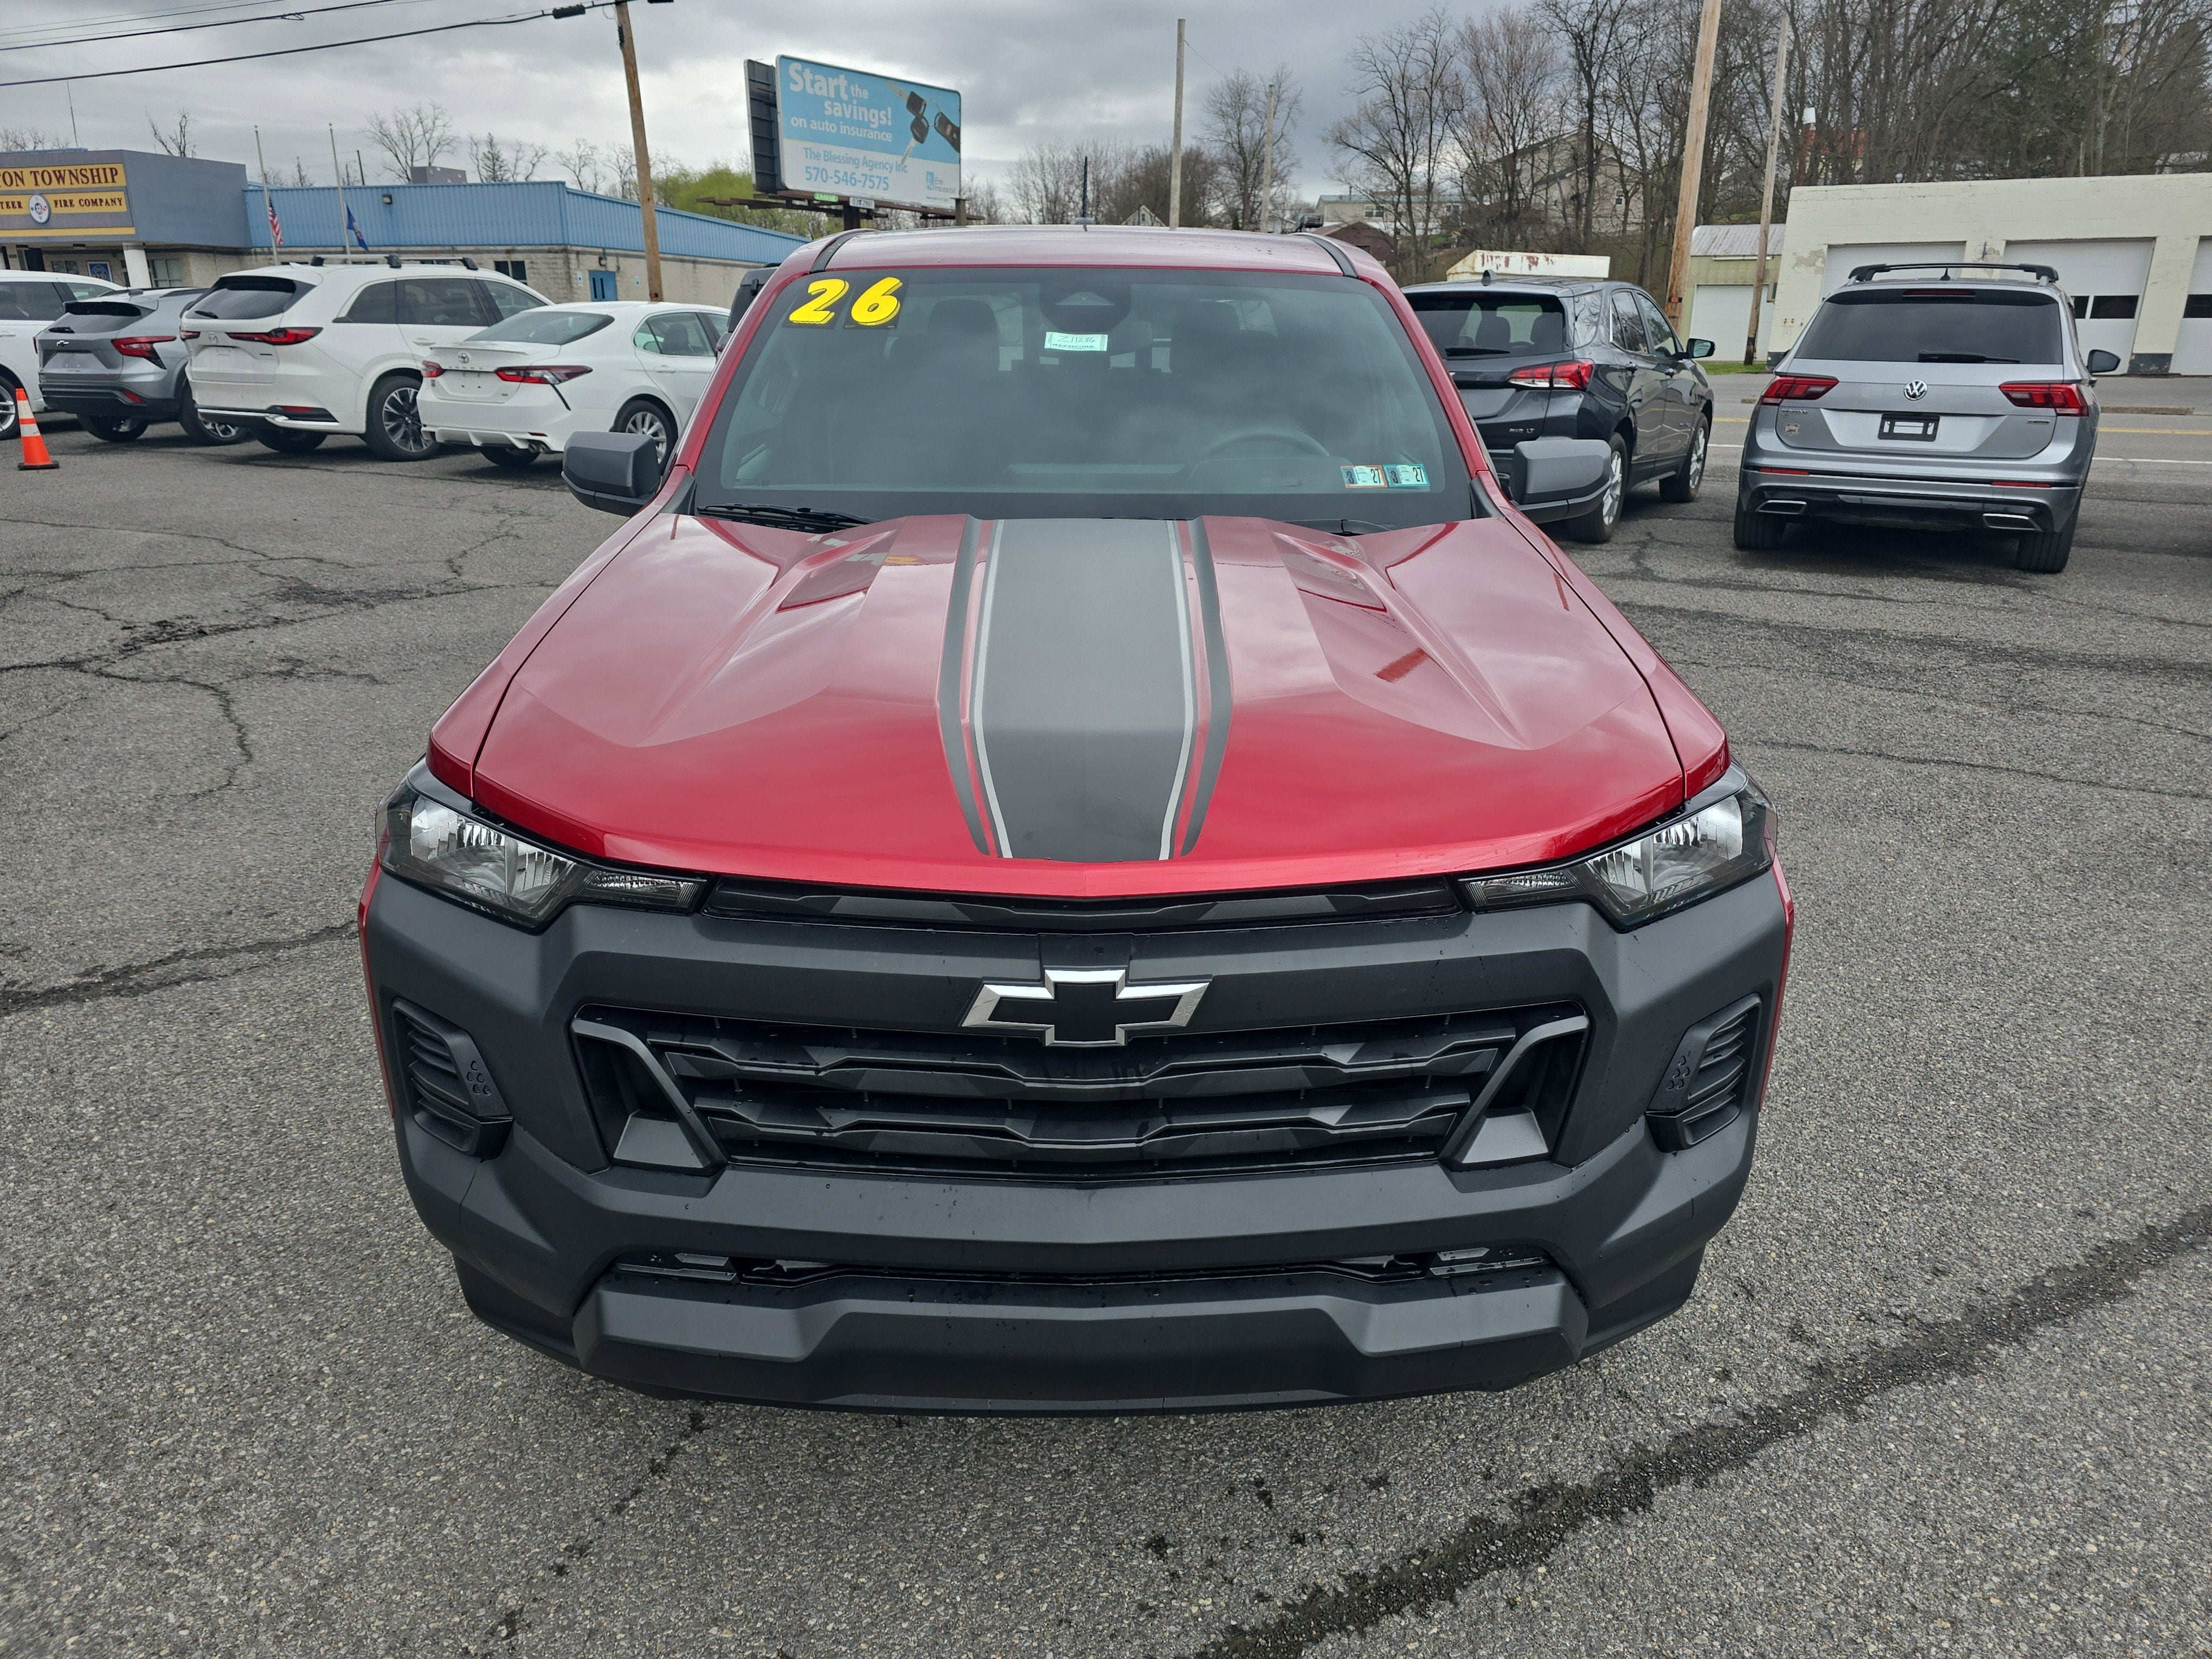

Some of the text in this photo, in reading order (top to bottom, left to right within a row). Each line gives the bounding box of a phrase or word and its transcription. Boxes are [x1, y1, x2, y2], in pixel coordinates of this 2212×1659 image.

[788, 62, 869, 100] Start the
[824, 99, 892, 128] savings!
[790, 116, 892, 142] on auto insurance
[803, 147, 908, 173] The Blessing Agency Inc
[0, 167, 118, 187] ON TOWNSHIP
[805, 165, 890, 190] 570-546-7575
[53, 198, 75, 208] FIRE
[79, 197, 123, 207] COMPANY
[1346, 468, 1381, 485] 3 27
[1390, 467, 1424, 484] 3 27
